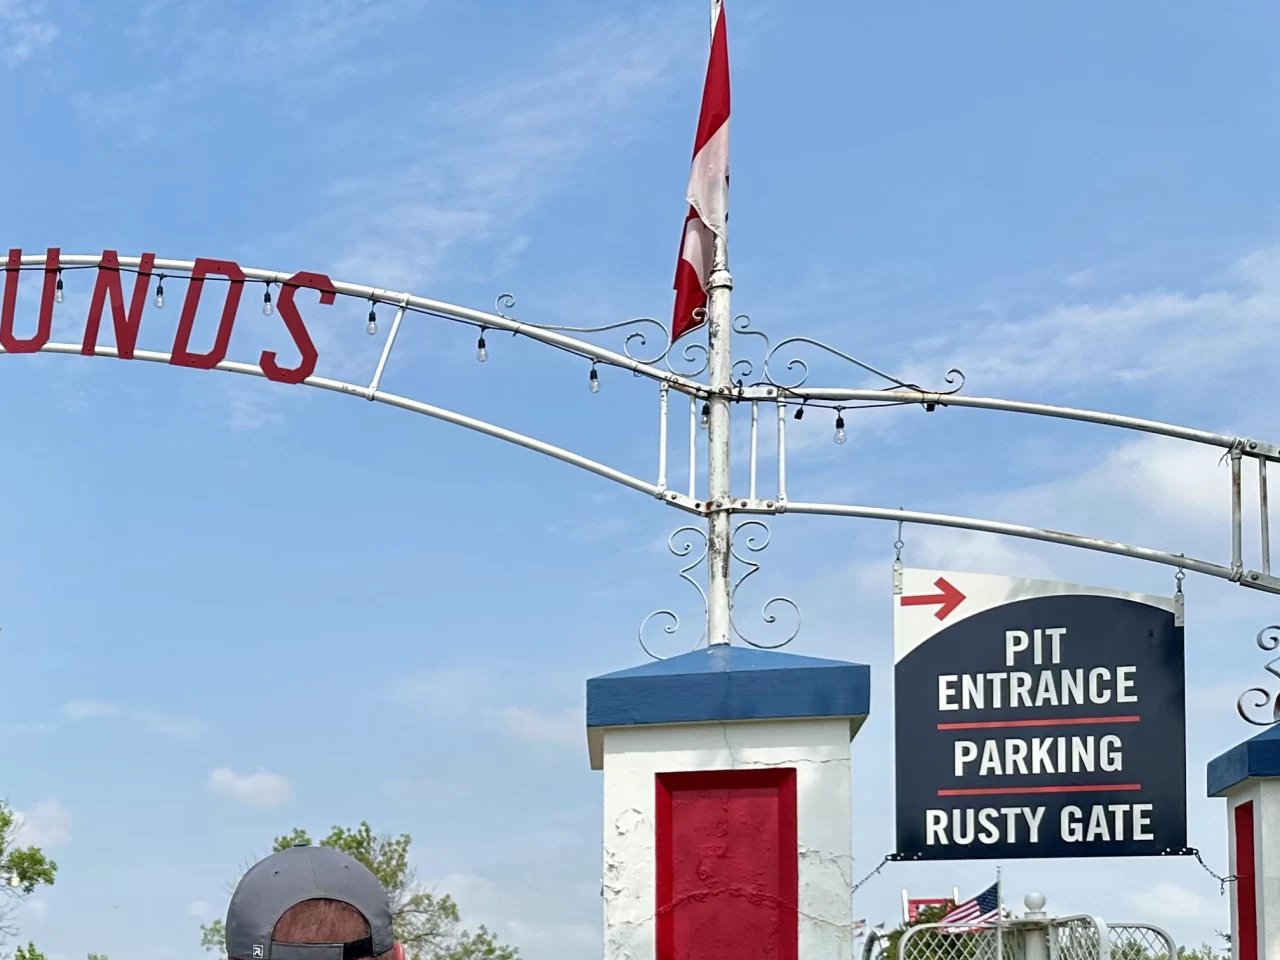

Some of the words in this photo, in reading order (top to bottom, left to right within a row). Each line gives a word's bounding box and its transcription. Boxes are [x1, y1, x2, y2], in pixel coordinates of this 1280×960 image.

[1005, 627, 1067, 666] PIT
[938, 665, 1138, 711] ENTRANCE
[954, 734, 1122, 776] PARKING
[925, 806, 1046, 845] RUSTY
[1060, 803, 1154, 842] GATE
